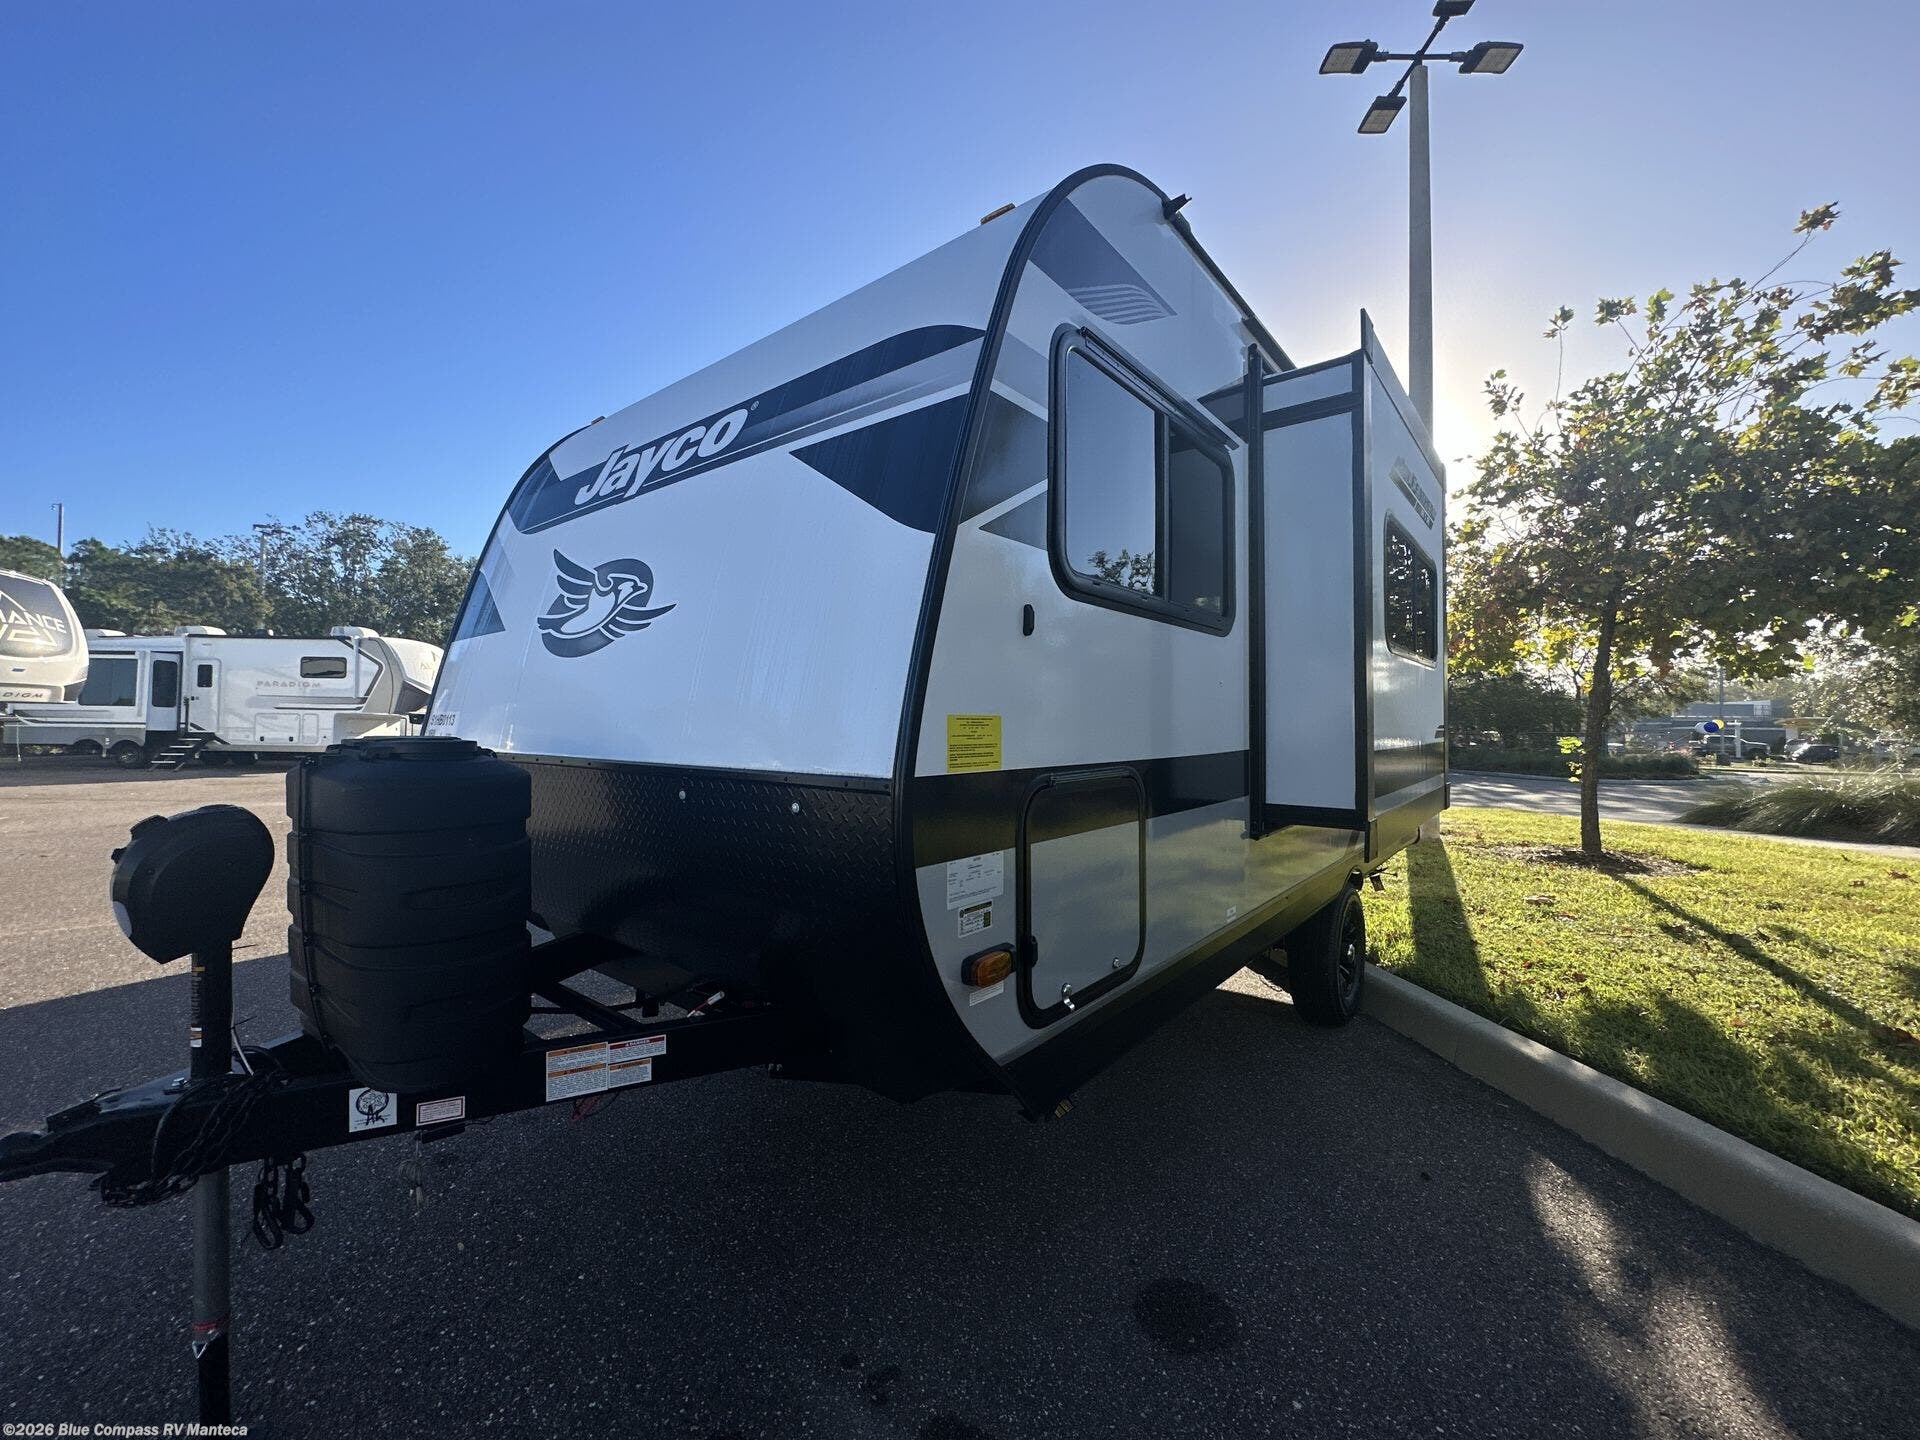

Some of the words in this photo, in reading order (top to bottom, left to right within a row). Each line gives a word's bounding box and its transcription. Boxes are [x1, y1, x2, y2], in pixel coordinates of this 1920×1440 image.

[574, 408, 749, 506] Jayco
[256, 680, 320, 688] PARADIGM
[2, 690, 43, 699] DIGM
